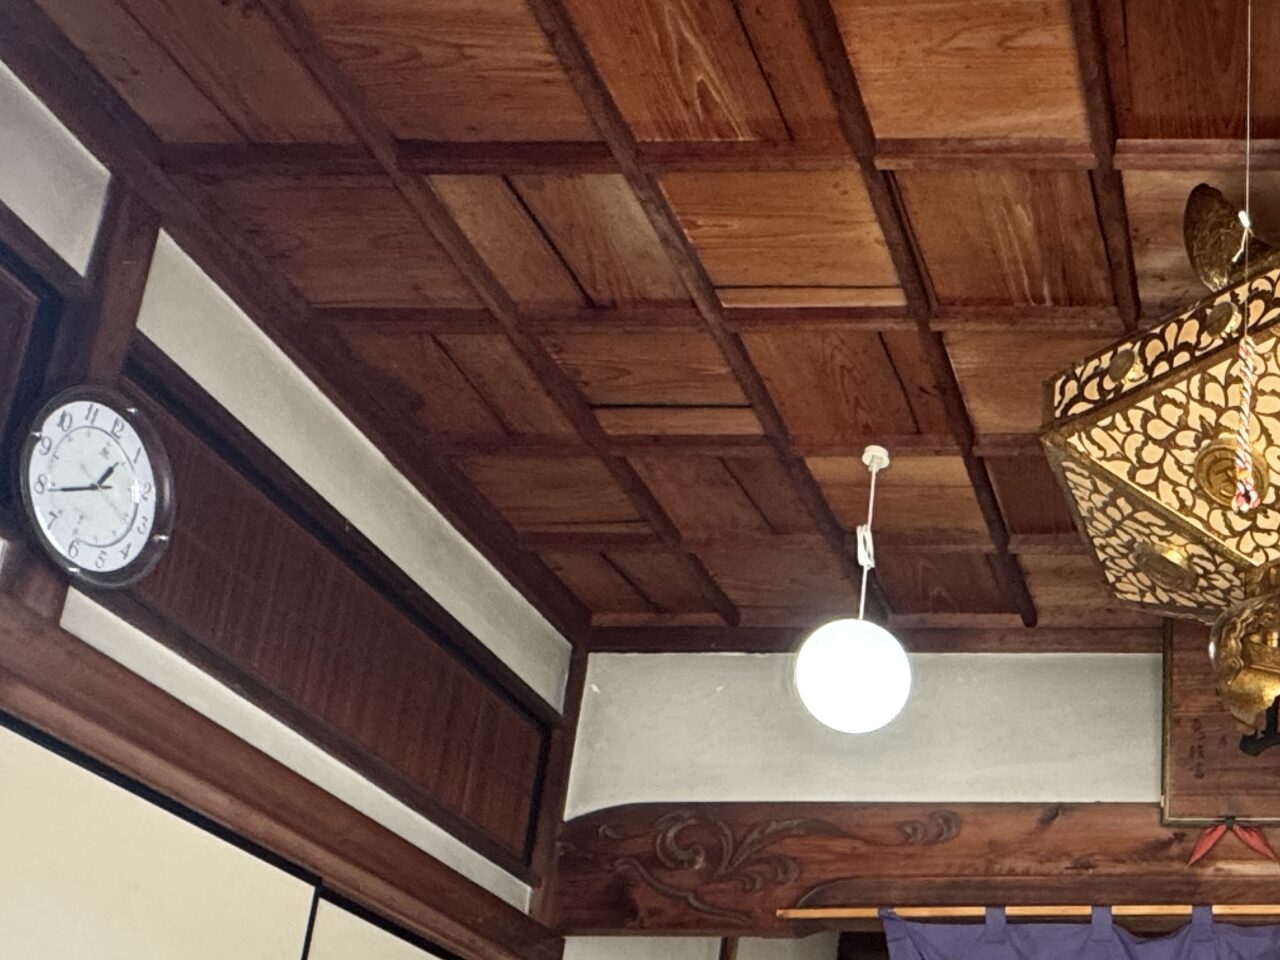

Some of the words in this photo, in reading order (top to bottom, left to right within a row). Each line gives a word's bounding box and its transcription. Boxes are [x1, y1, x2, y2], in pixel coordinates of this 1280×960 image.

[57, 410, 73, 432] 10
[85, 404, 99, 425] 11
[110, 417, 124, 439] 12
[40, 437, 52, 455] 9
[34, 474, 48, 494] 8
[141, 483, 150, 500] 2
[48, 512, 58, 530] 7
[138, 516, 148, 535] 3
[68, 540, 79, 559] 6
[120, 543, 131, 560] 4
[95, 551, 107, 568] 5
